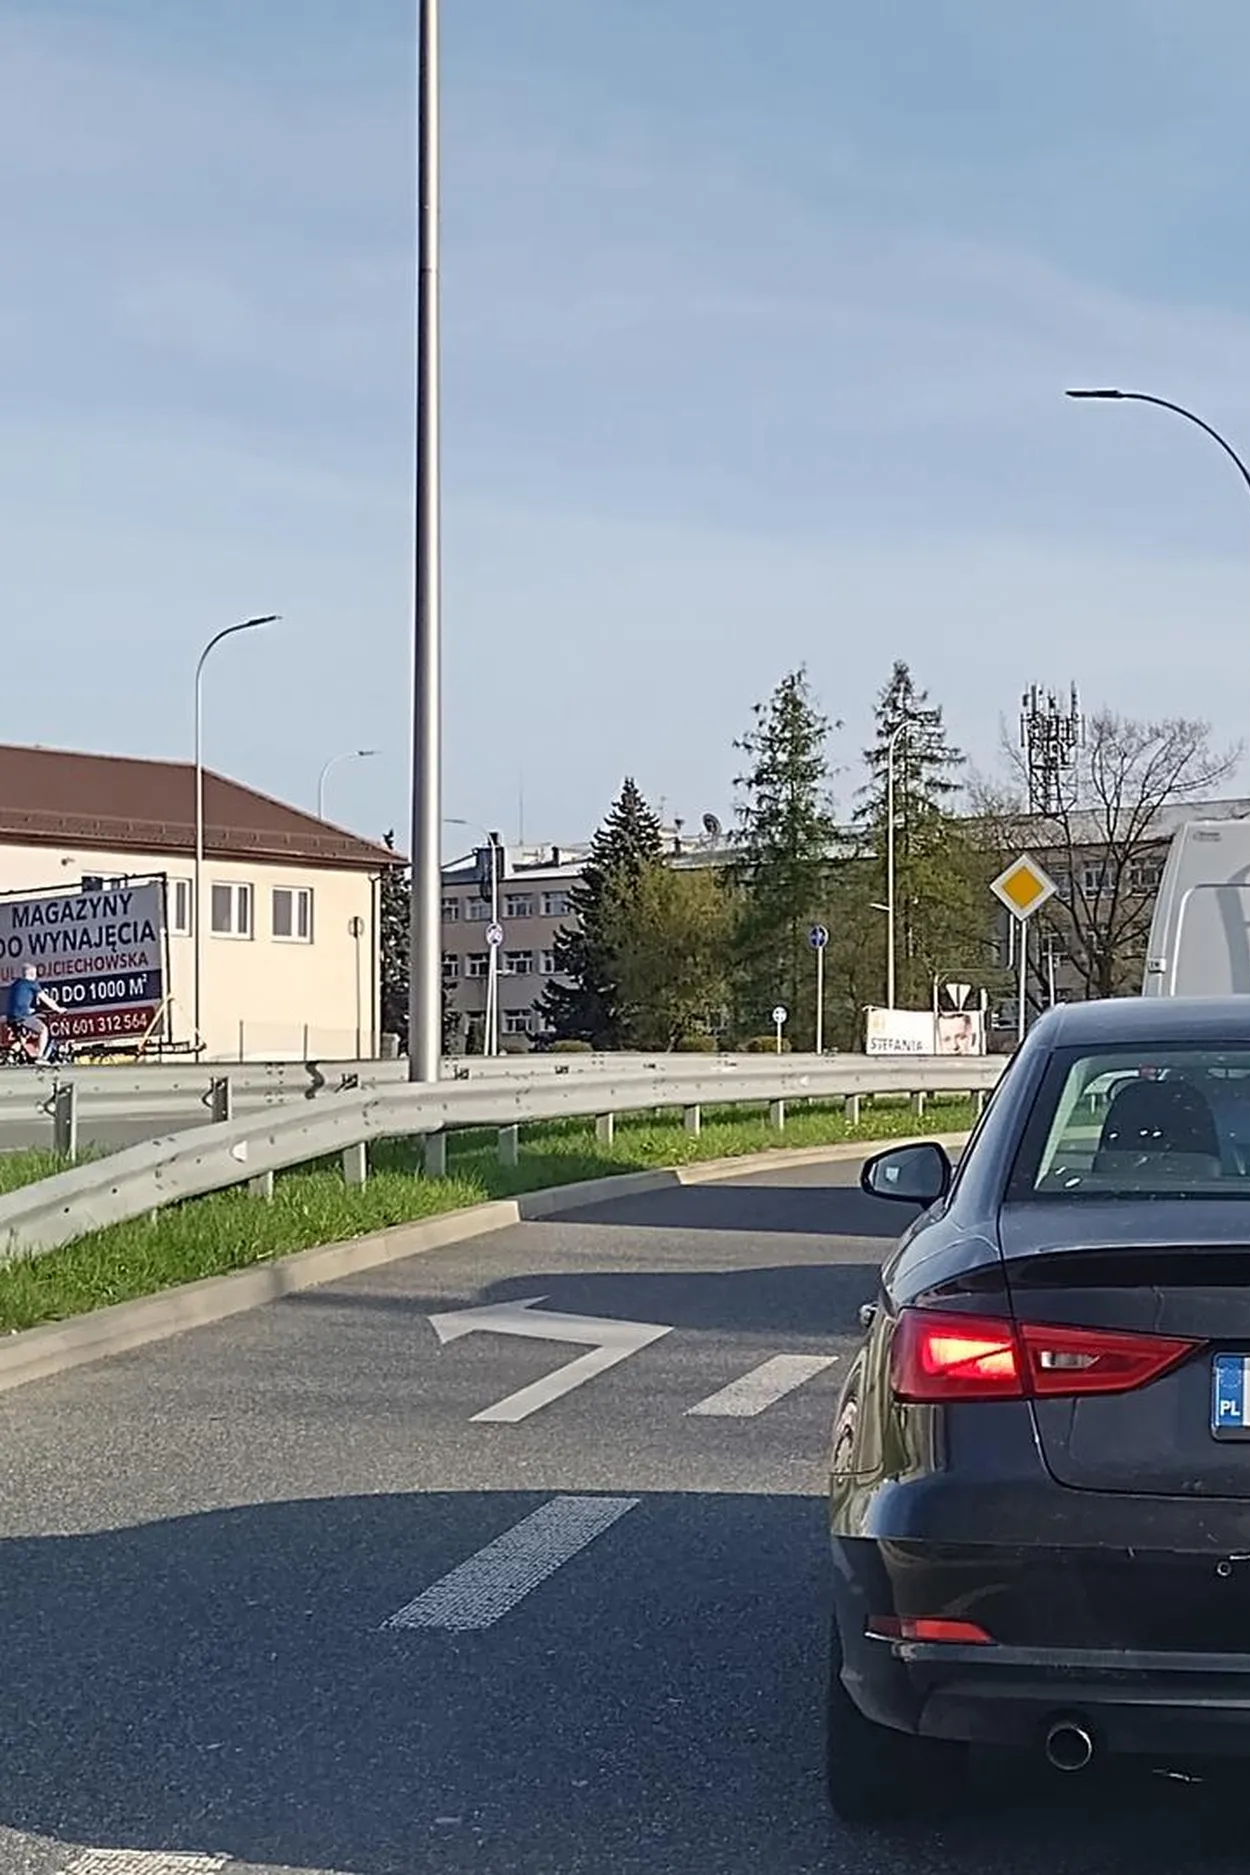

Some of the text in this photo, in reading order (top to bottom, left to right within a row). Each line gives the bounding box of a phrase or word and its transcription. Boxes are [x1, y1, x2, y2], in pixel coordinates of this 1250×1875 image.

[12, 892, 133, 928] MAGAZYNY
[28, 920, 156, 953] WYNAJĘCIA
[24, 951, 149, 978] OJCIECHOWSKA
[62, 985, 86, 1003] DO
[90, 980, 126, 1000] 1000
[72, 1018, 95, 1034] 601
[98, 1015, 122, 1032] 312
[123, 1012, 148, 1029] 564
[1219, 1401, 1241, 1417] PL
